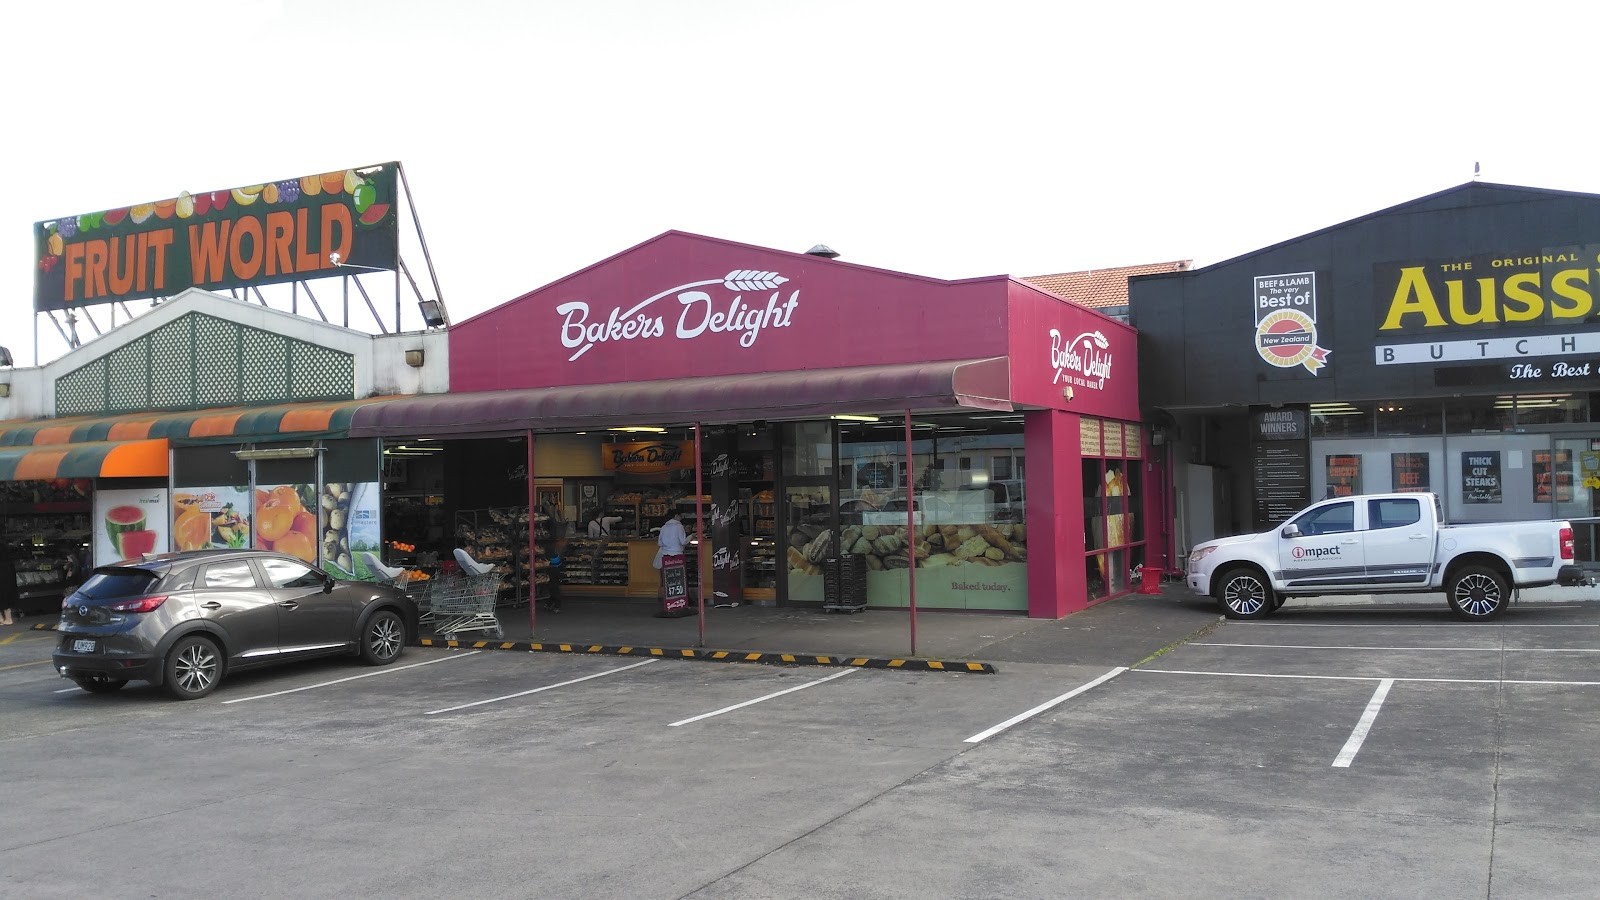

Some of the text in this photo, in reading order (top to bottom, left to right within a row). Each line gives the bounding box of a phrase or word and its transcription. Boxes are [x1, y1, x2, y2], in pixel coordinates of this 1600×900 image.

[64, 202, 353, 301] FRUIT WORLD
[1441, 253, 1579, 272] THE ORIGINAL
[1259, 280, 1279, 289] BEEF
[1286, 277, 1310, 287] LAMB
[1259, 291, 1310, 308] Best of
[556, 289, 800, 348] Bakers Delight
[1263, 335, 1310, 345] New Zealand
[1049, 328, 1112, 391] Bakers Delight
[1509, 363, 1543, 380] The
[1551, 361, 1591, 378] Best
[1264, 411, 1293, 422] AWARD
[1260, 422, 1297, 433] WINNERS
[647, 448, 682, 466] Delight
[1468, 457, 1493, 466] THICK
[1472, 467, 1488, 476] CUT
[1465, 478, 1496, 487] STEAKS
[1292, 545, 1341, 558] impact
[951, 582, 1011, 593] Baked today.
